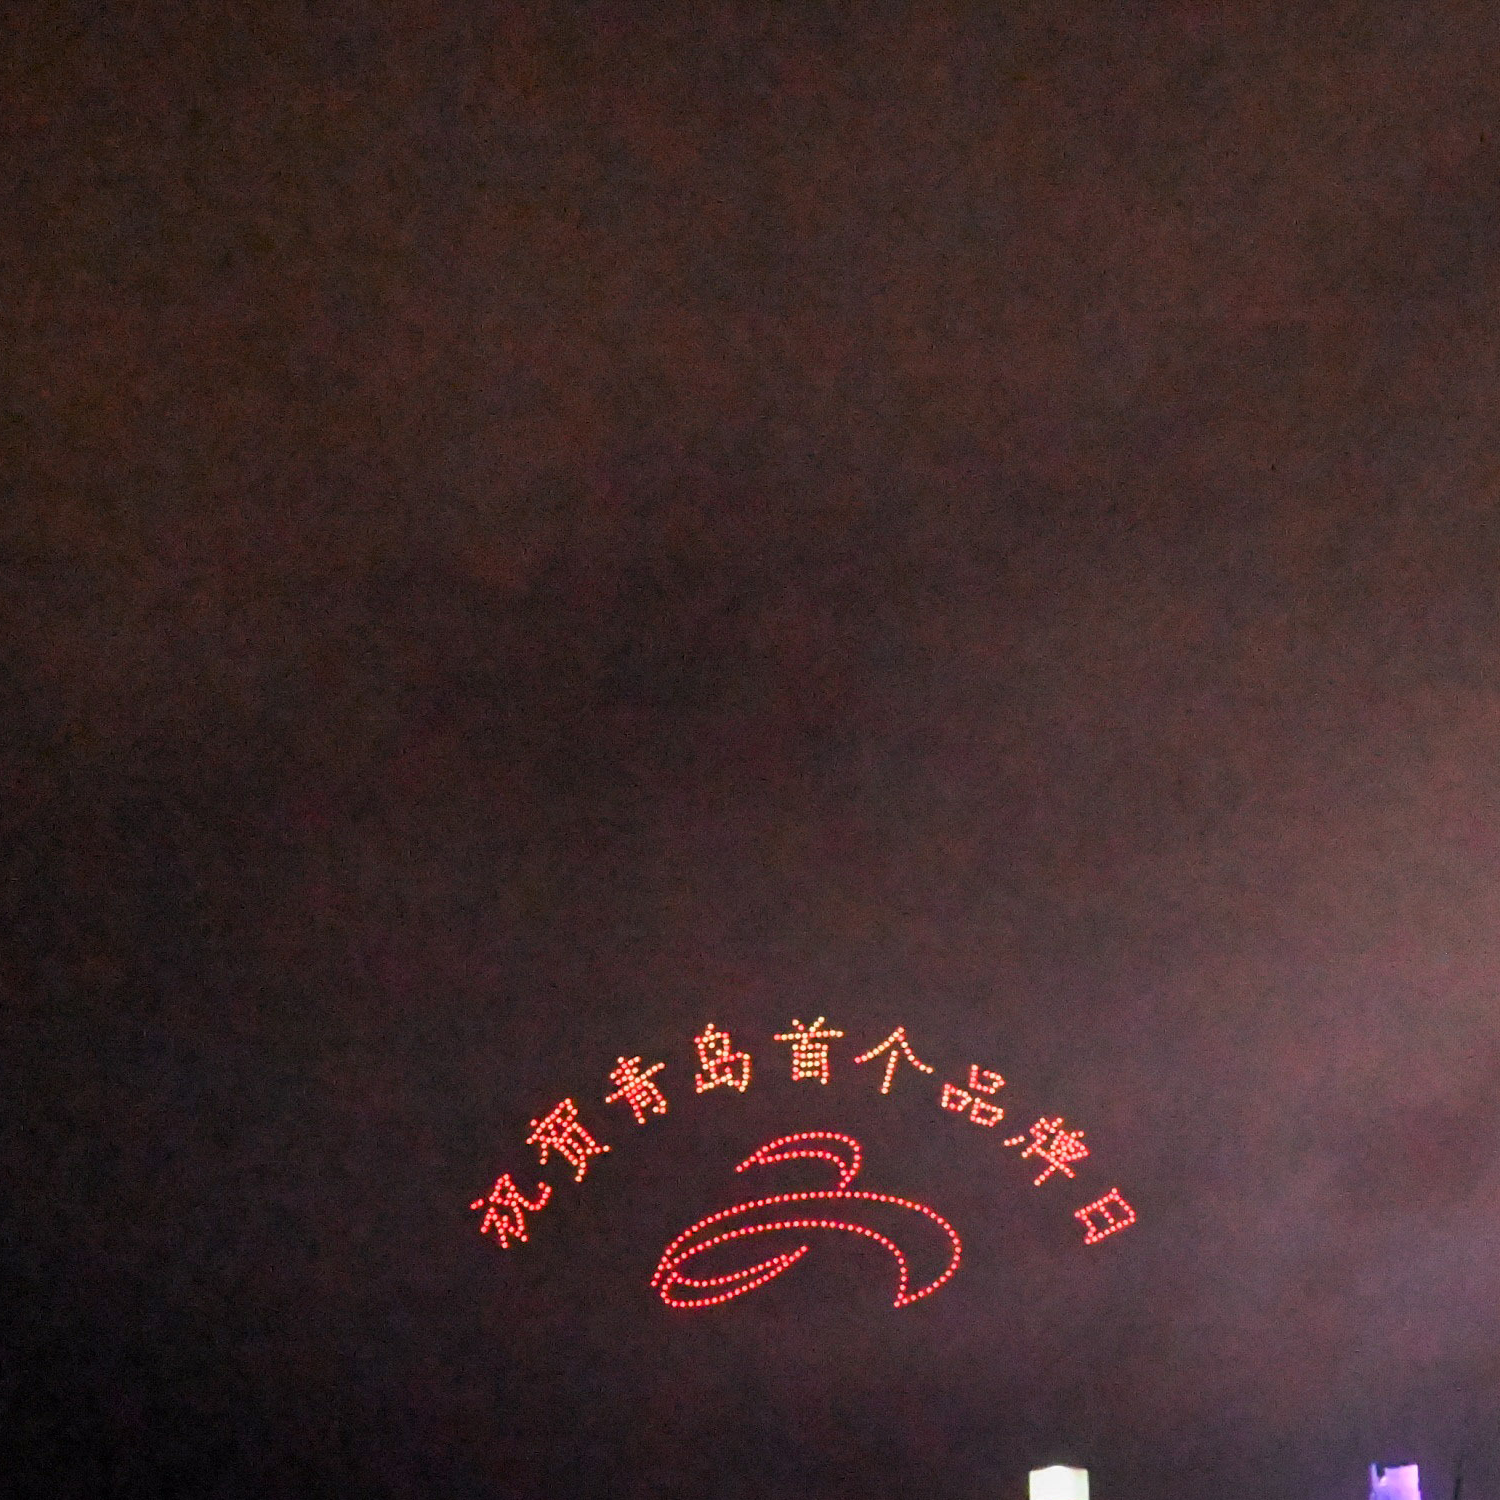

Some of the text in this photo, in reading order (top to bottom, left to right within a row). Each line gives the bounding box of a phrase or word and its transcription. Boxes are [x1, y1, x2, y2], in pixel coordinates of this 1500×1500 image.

[470, 1016, 1137, 1249] 祝贺青岛首个品牌日
